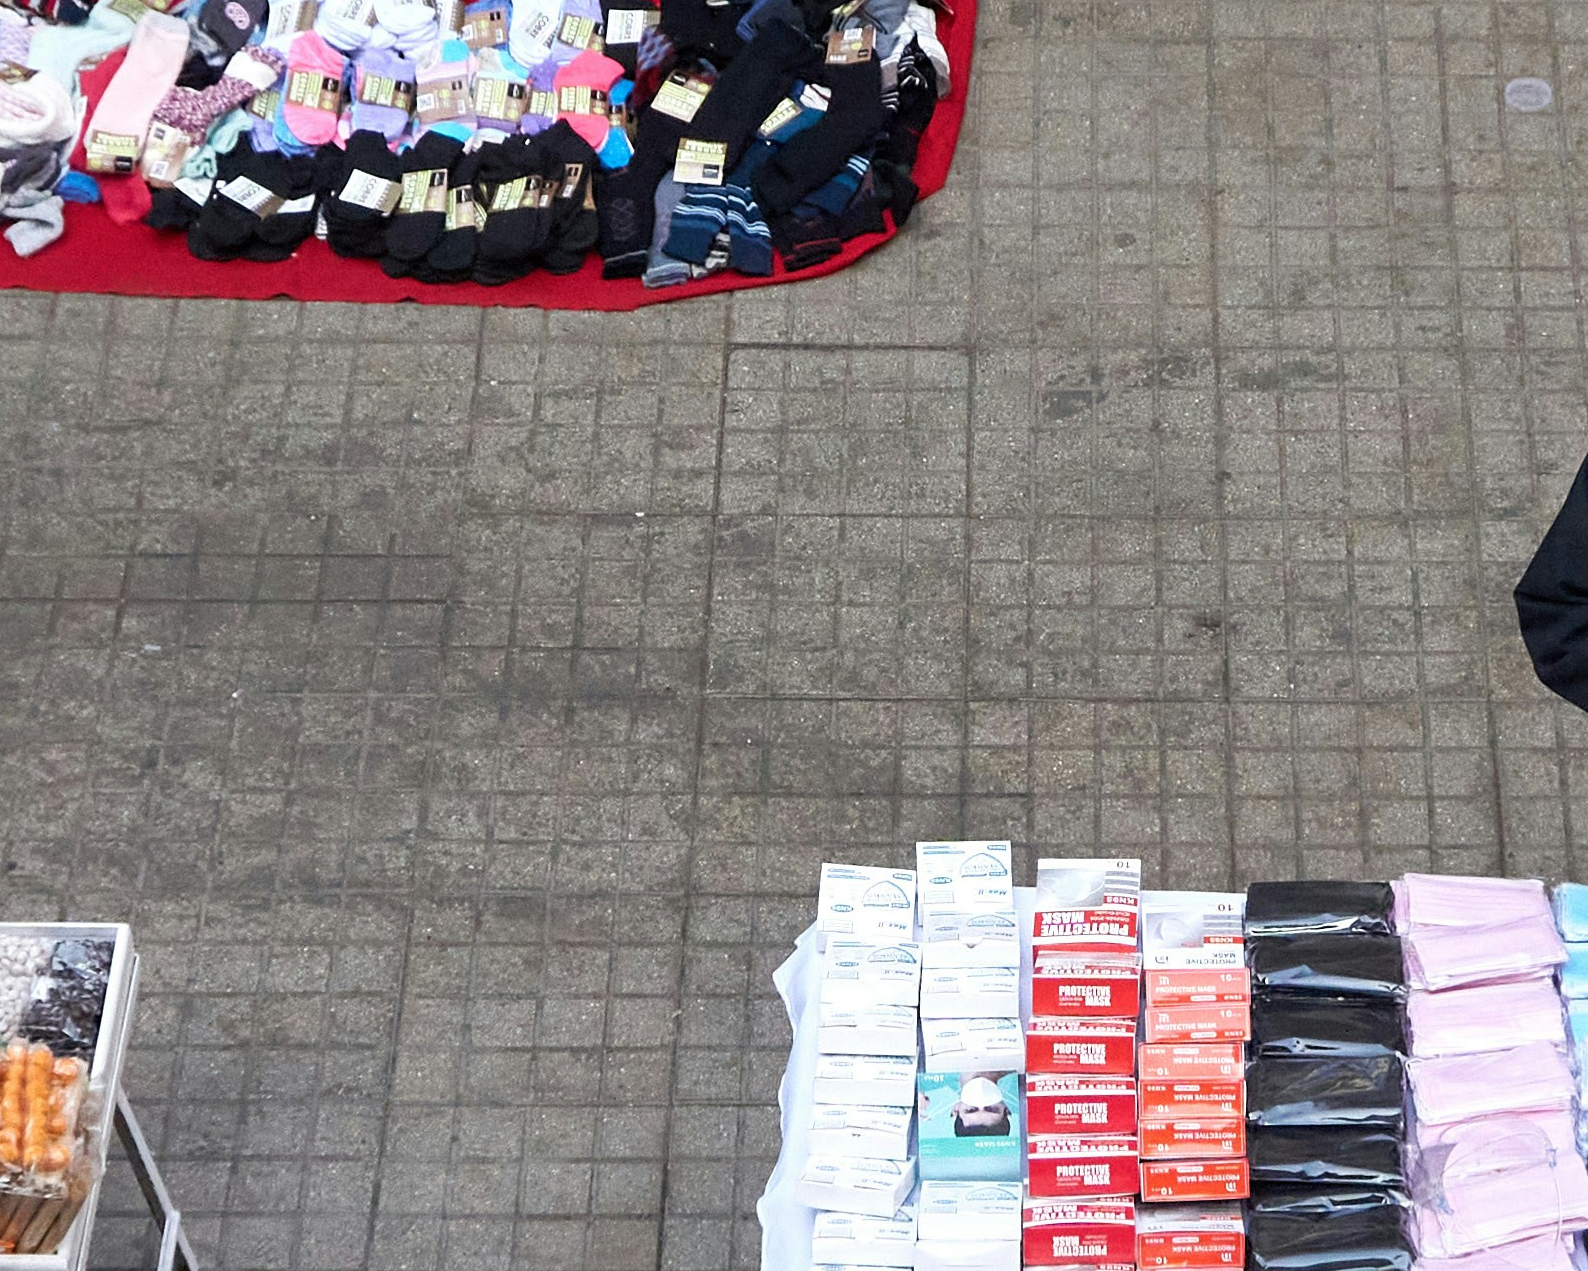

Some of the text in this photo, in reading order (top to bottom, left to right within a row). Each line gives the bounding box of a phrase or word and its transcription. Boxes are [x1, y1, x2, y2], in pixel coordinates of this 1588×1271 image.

[1116, 861, 1131, 869] 10
[1217, 904, 1233, 912] 10
[1041, 912, 1086, 925] MASK
[1040, 922, 1130, 937] PROTECTIVE
[1058, 985, 1112, 996] PROTECTIVE
[1084, 995, 1112, 1007] MASK
[1053, 1043, 1106, 1054] PROTECTIVE
[1079, 1054, 1106, 1065] MASK
[1054, 1102, 1108, 1114] PROTECTIVE
[1081, 1113, 1108, 1124] MASK
[1056, 1164, 1110, 1177] PROTECTIVE
[1083, 1174, 1111, 1186] MASK
[1052, 1235, 1080, 1246] MASK
[1052, 1245, 1108, 1257] PROTECTIVE
